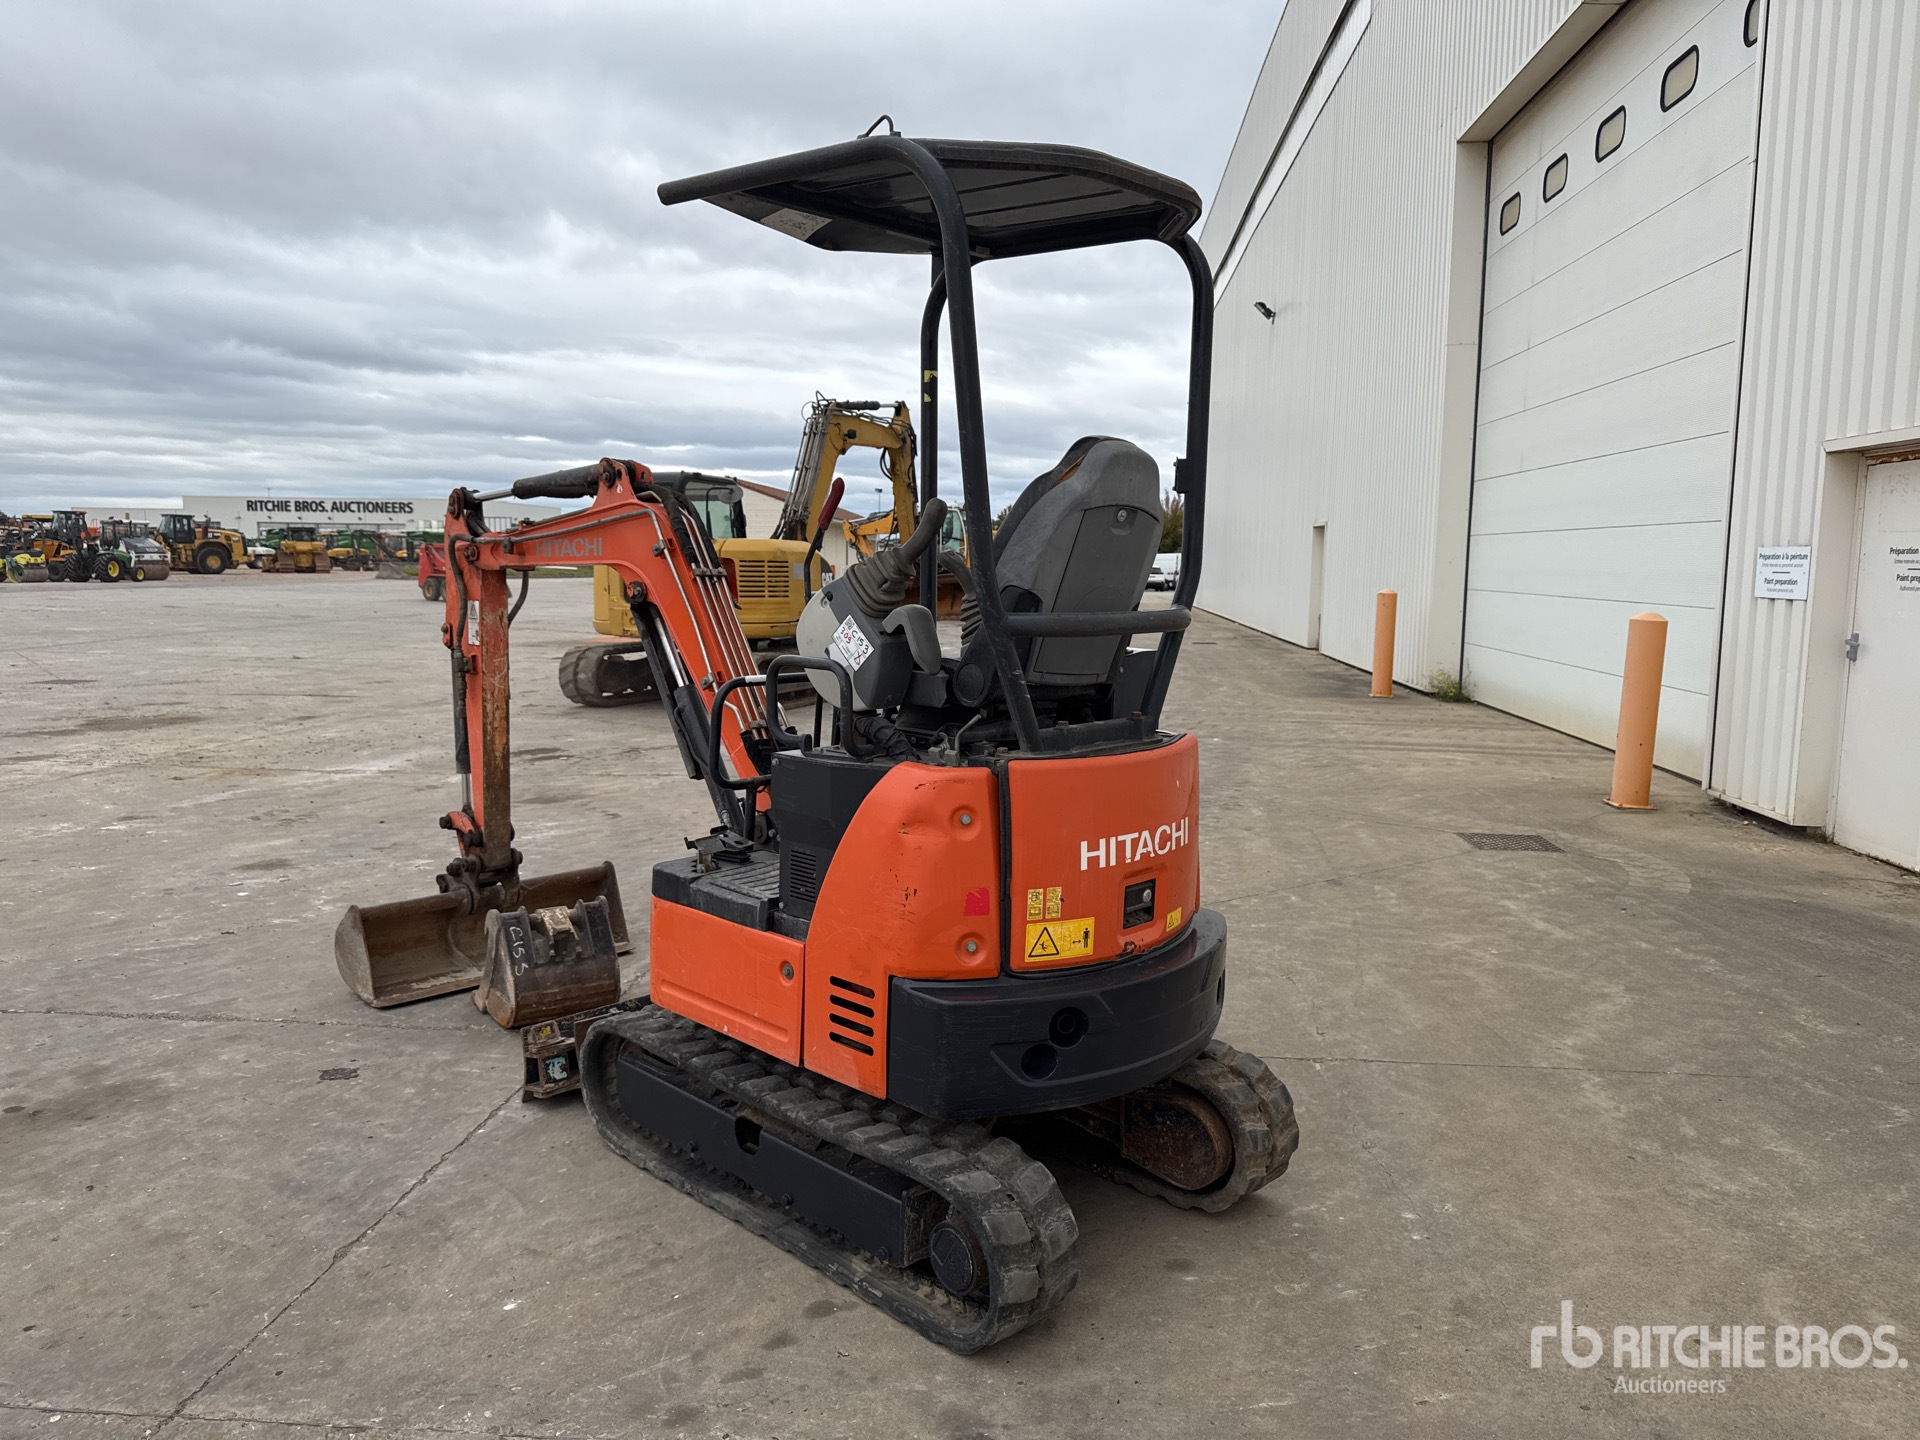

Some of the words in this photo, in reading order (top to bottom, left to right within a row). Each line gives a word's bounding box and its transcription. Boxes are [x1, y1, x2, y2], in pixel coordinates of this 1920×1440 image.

[246, 500, 292, 512] RITCHIE
[294, 500, 329, 513] BROS.
[330, 501, 414, 514] AUCTIONEERS
[535, 537, 603, 558] HITACHI
[821, 572, 833, 587] CAT
[1764, 577, 1774, 585] Paint
[1896, 573, 1910, 581] Paint
[1080, 816, 1189, 871] HITACHI
